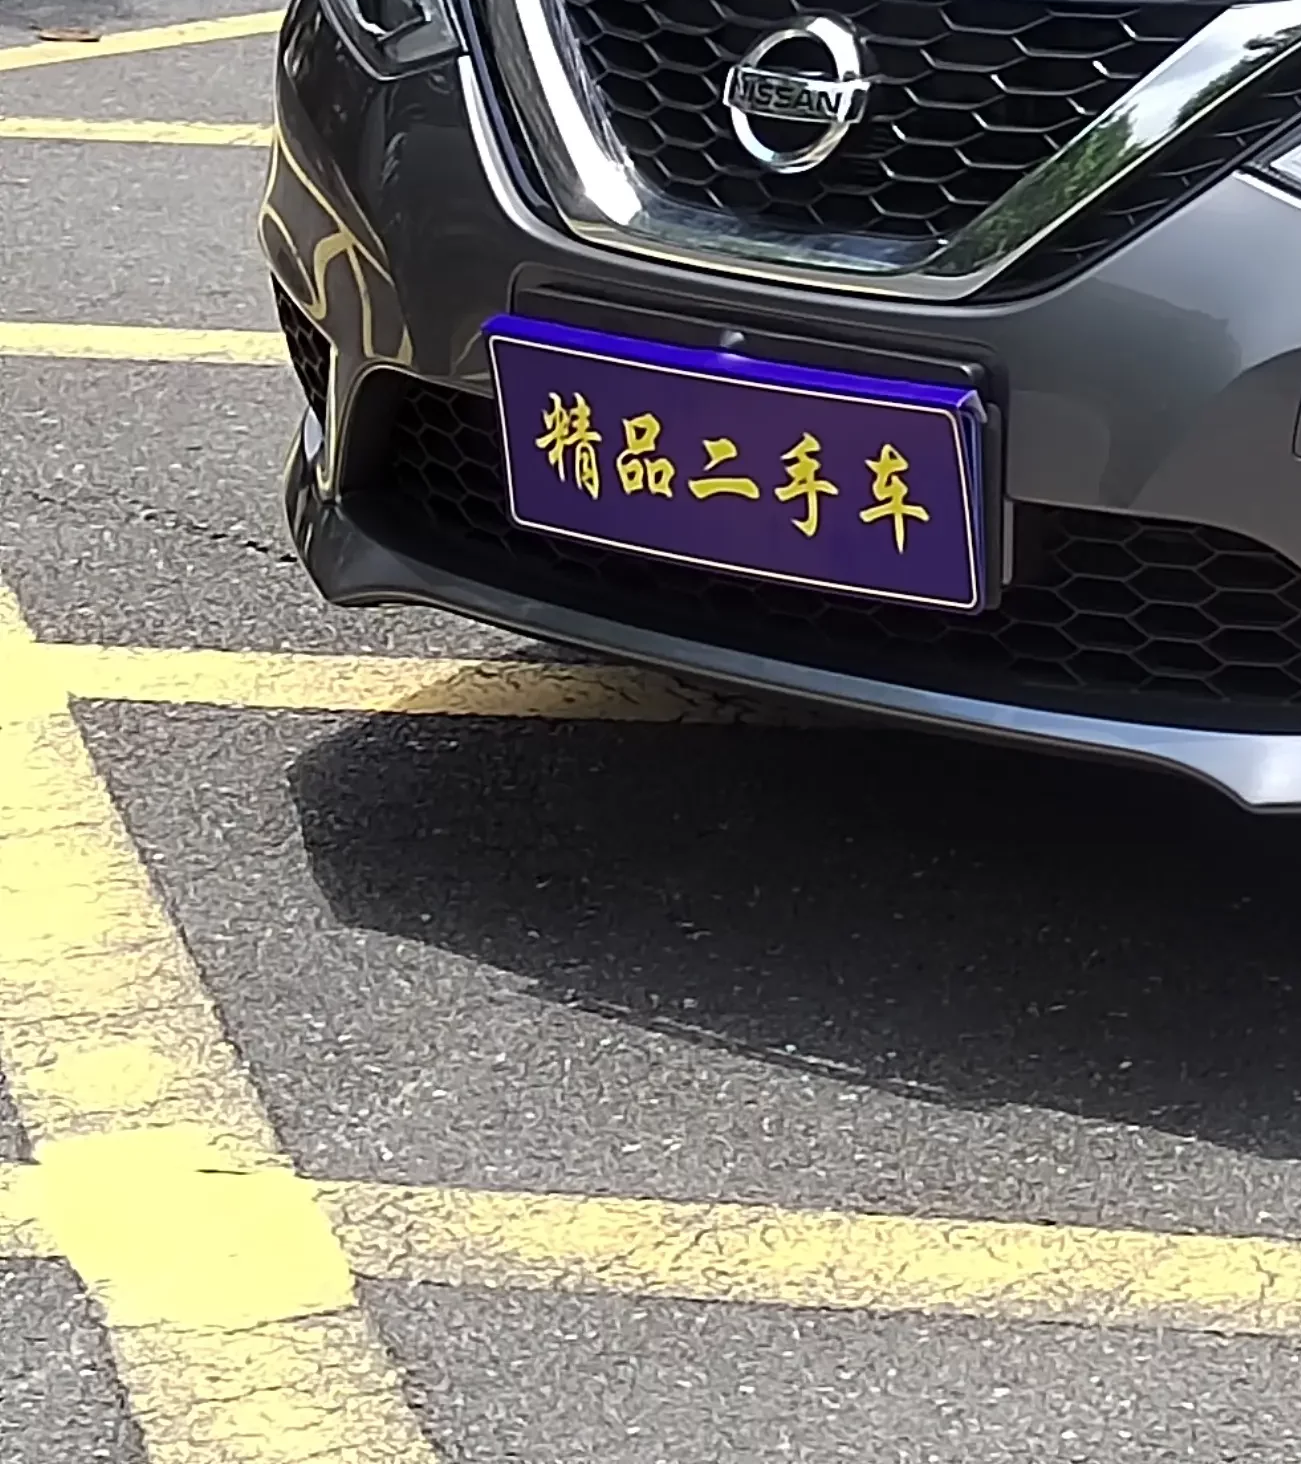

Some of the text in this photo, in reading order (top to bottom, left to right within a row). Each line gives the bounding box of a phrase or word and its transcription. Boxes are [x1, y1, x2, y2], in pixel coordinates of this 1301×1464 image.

[731, 70, 843, 113] NISSAN
[535, 392, 930, 554] 精品二手车
